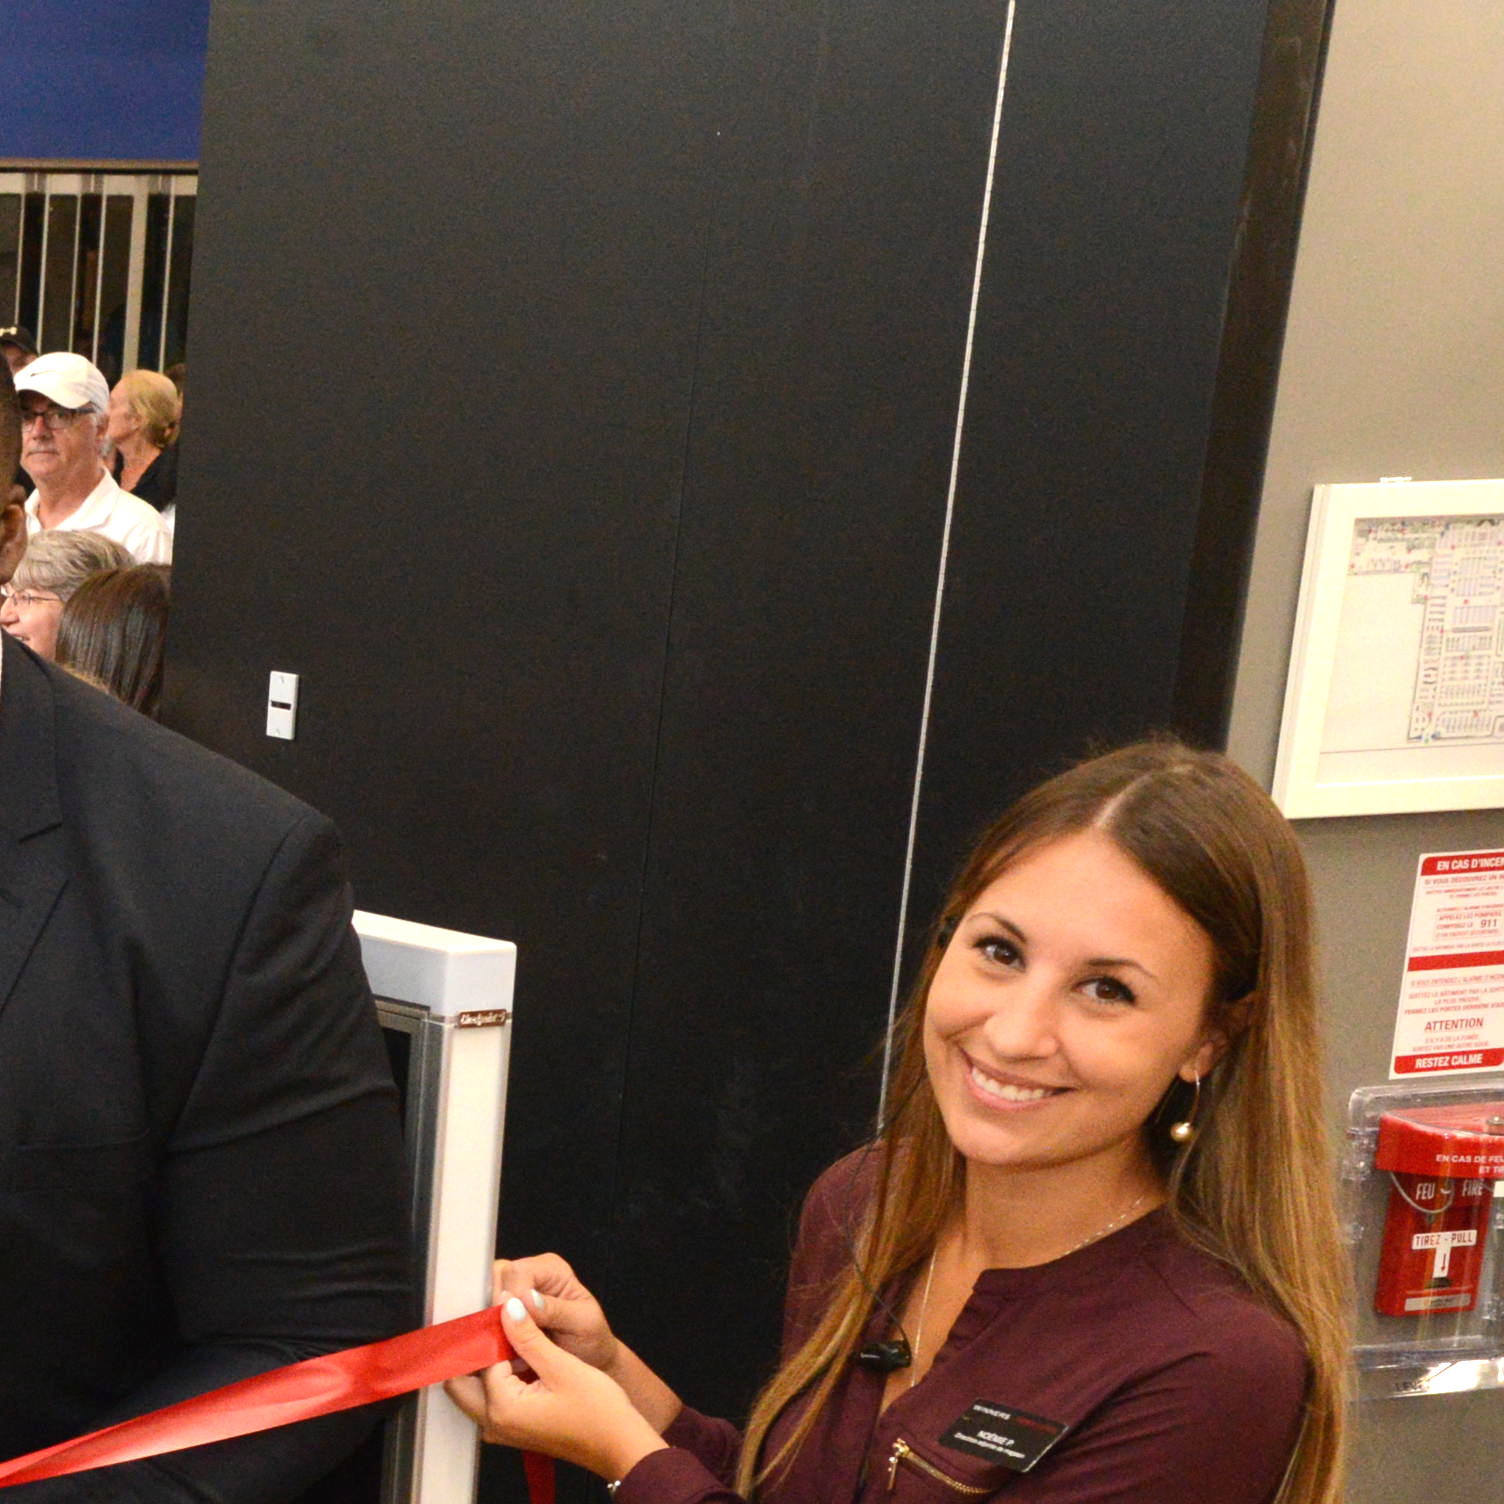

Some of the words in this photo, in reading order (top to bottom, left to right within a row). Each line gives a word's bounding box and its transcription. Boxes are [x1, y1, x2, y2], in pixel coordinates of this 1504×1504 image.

[1436, 860, 1450, 871] EN
[1451, 858, 1470, 870] CAS
[1480, 918, 1498, 929] 911
[1423, 1017, 1485, 1032] ATTENTION
[1415, 1056, 1450, 1069] RESTEZ
[1451, 1053, 1485, 1066] CALME
[1436, 1154, 1450, 1163] EN
[1451, 1155, 1472, 1163] CAS
[1415, 1183, 1436, 1201] FEU
[1462, 1179, 1483, 1197] FIRE
[1415, 1235, 1441, 1247] TIREZ
[1451, 1232, 1473, 1244] PULL
